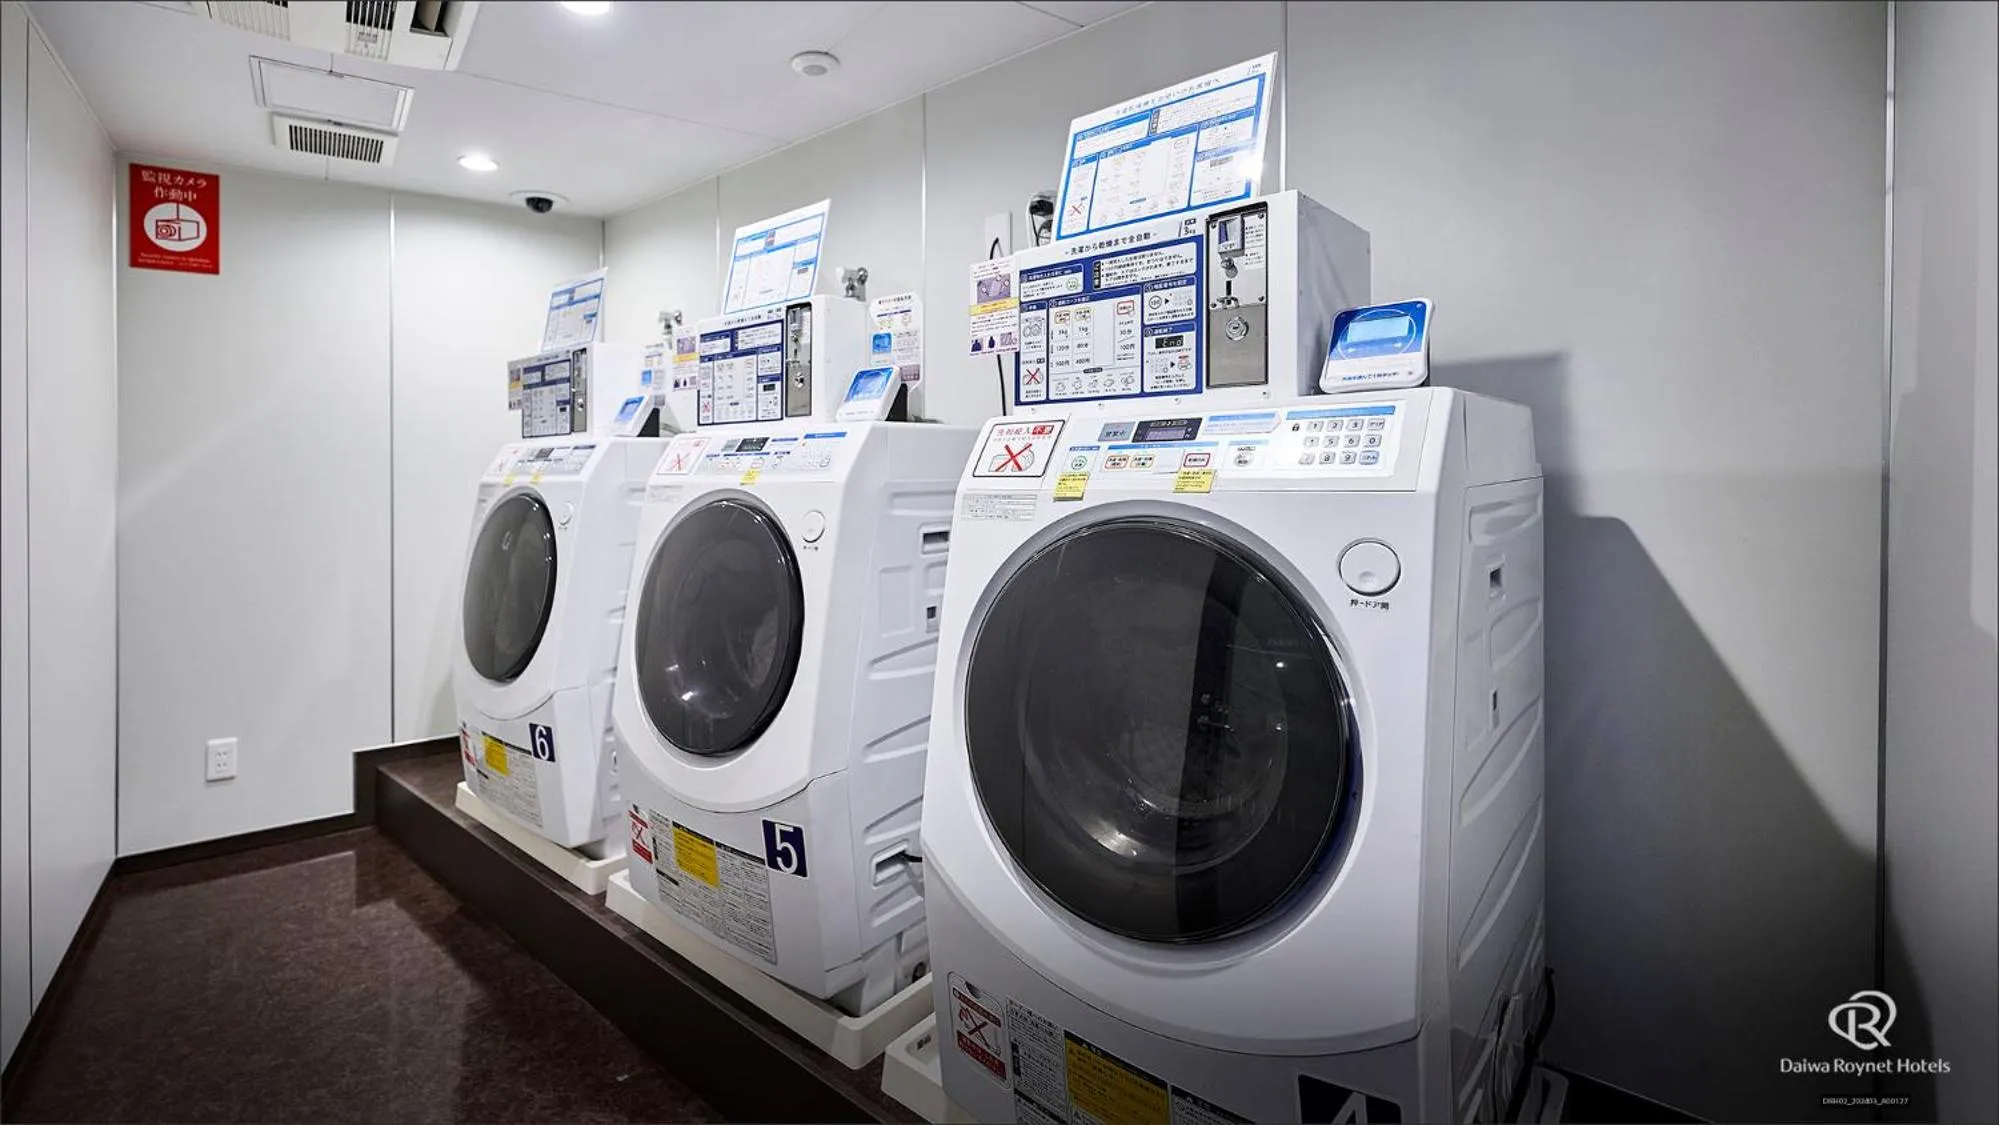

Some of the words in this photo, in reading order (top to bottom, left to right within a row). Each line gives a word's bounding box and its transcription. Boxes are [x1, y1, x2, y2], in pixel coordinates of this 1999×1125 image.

[141, 169, 207, 189] 監視カメラ
[154, 186, 197, 202] 作動中
[535, 725, 549, 760] 6
[775, 823, 798, 874] 5
